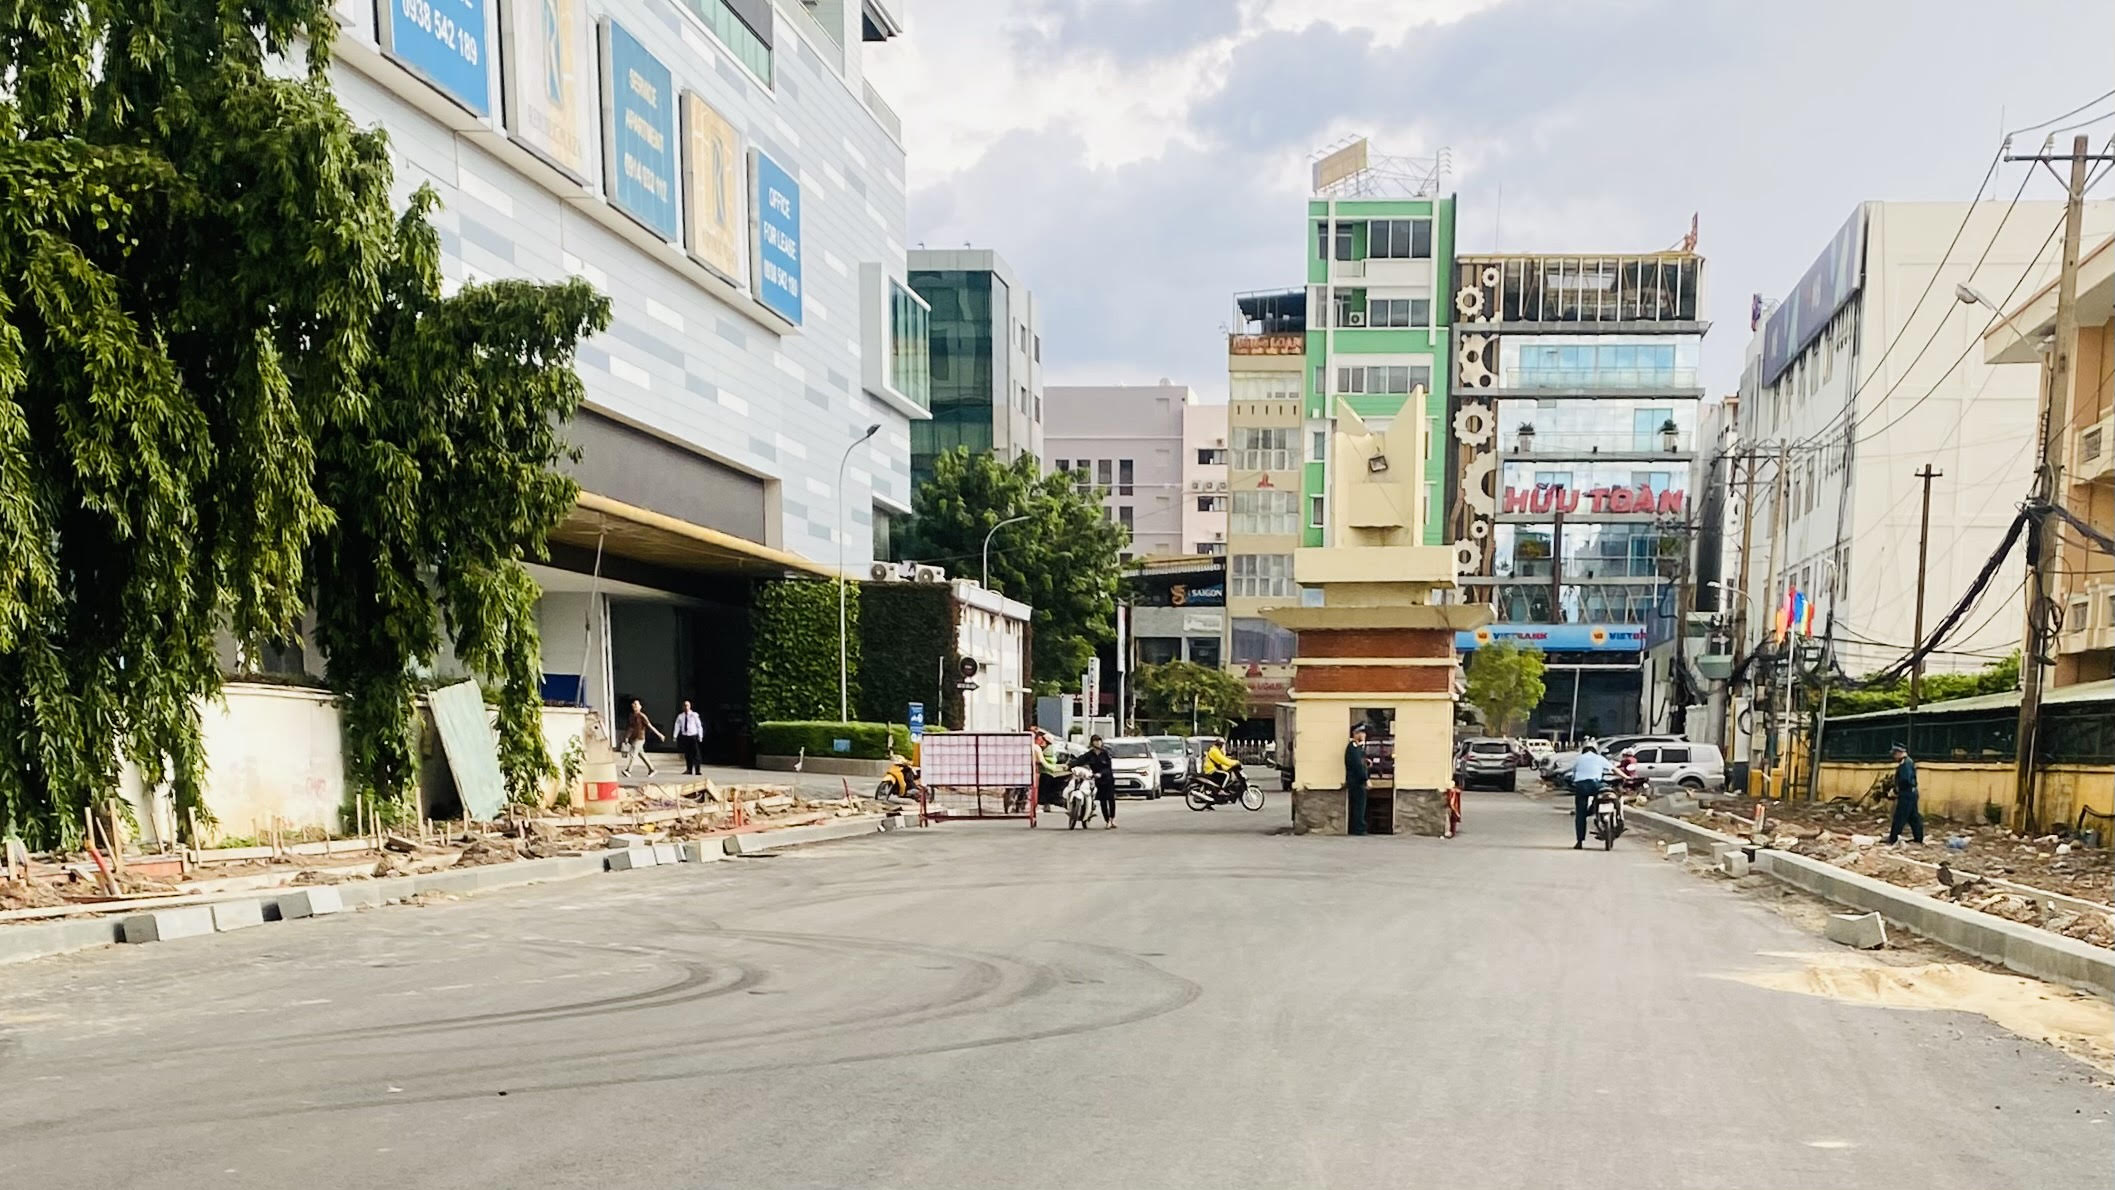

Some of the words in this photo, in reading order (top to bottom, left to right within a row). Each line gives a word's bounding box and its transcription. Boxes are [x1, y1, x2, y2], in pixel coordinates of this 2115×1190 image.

[402, 0, 432, 33] 0938
[434, 8, 456, 51] 542
[457, 27, 478, 66] 189
[625, 106, 664, 154] APARTMENT
[768, 186, 791, 220] OFFICE
[763, 220, 777, 246] FOR
[777, 232, 797, 261] LEASE
[1503, 482, 1580, 513] HỮU
[1191, 589, 1223, 598] SAIGON
